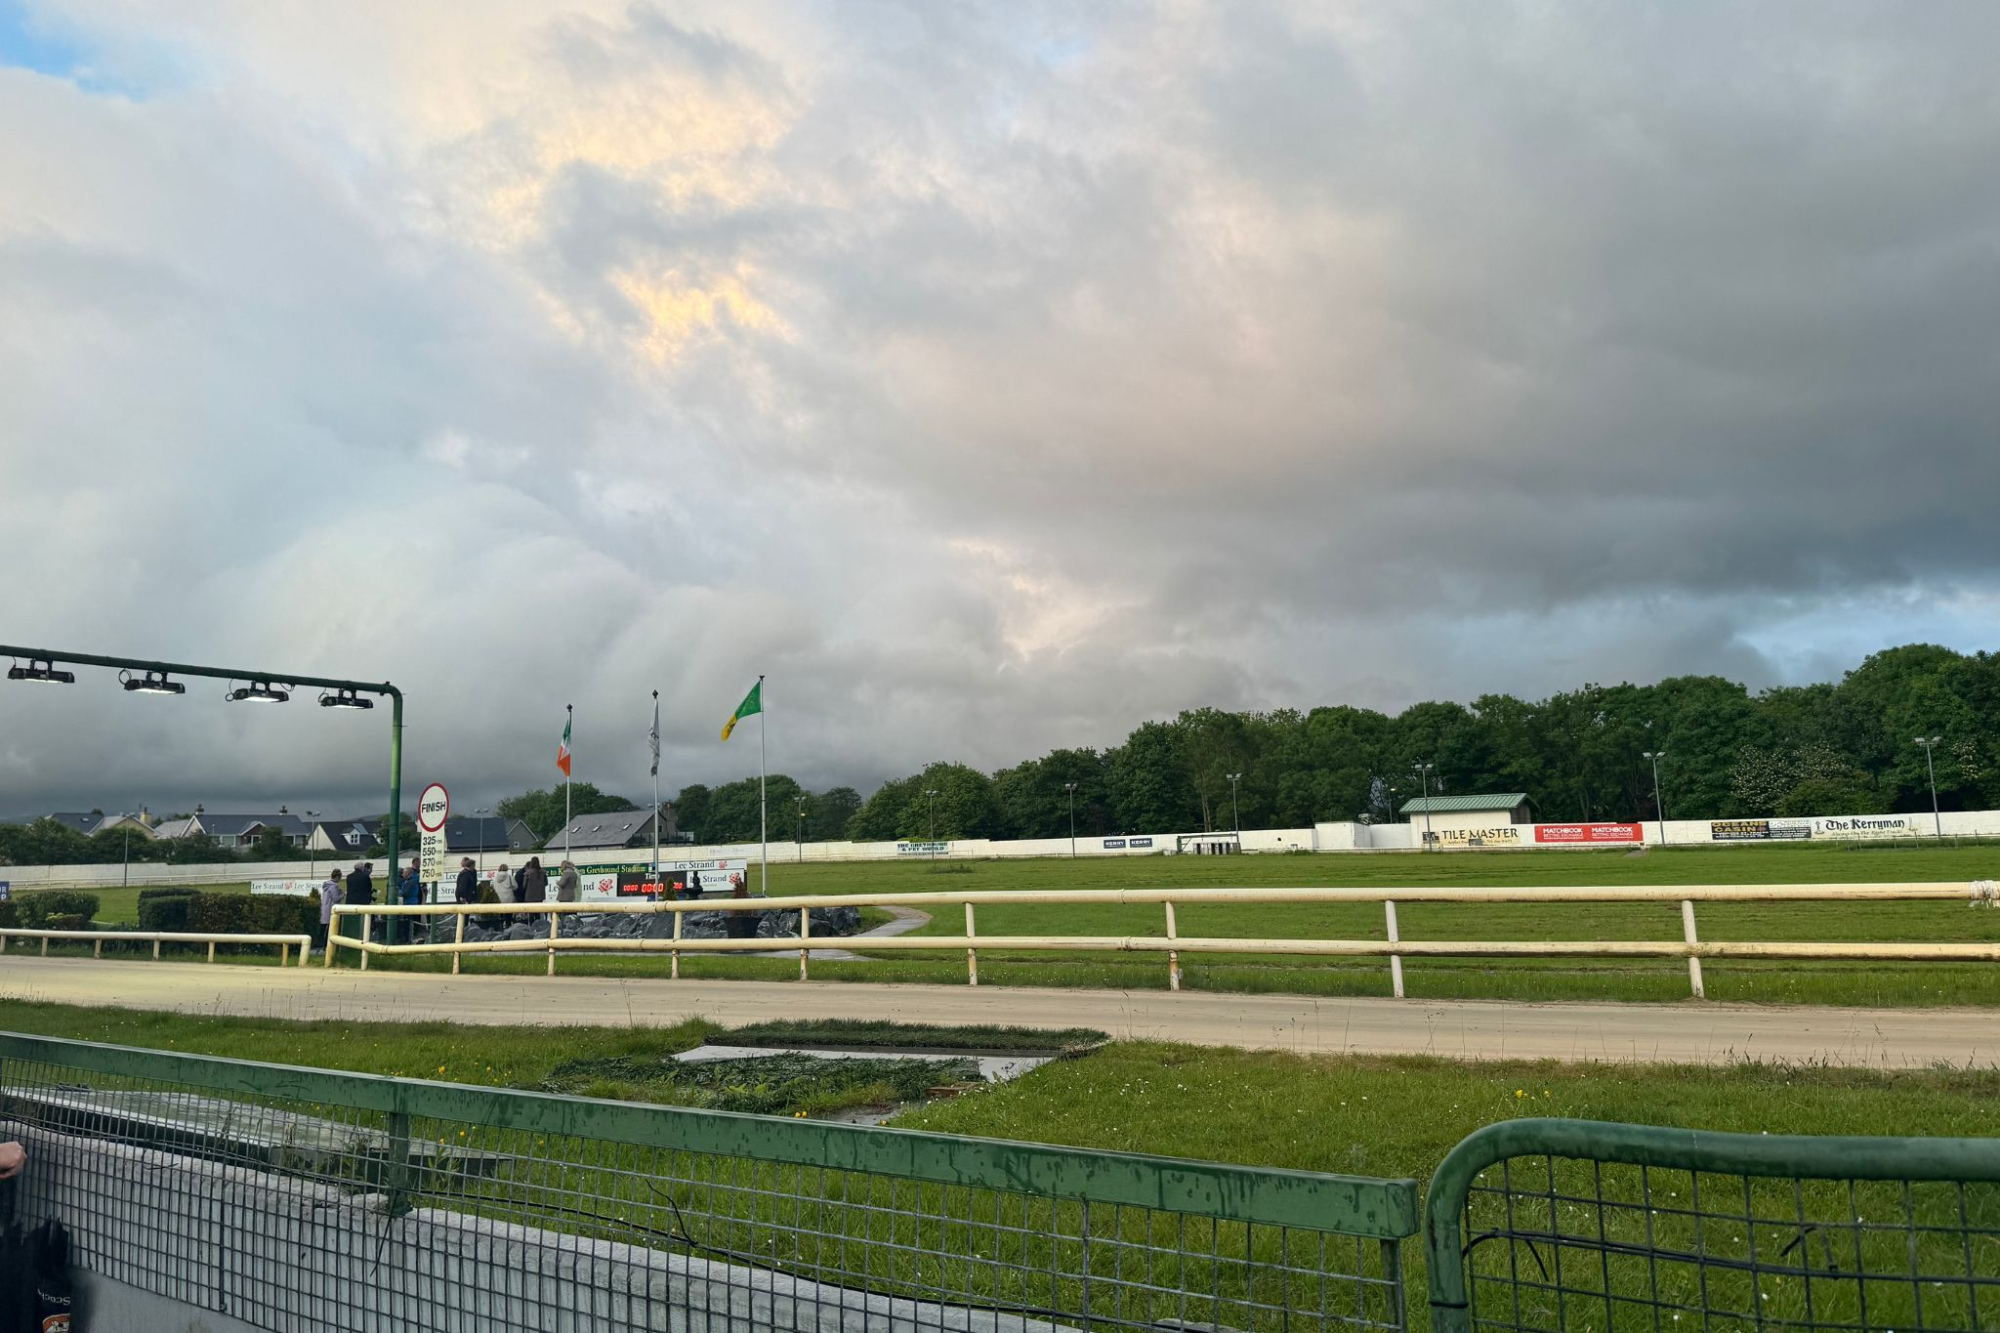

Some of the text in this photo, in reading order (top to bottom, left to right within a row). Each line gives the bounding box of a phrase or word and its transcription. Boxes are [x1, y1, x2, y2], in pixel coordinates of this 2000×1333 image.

[422, 802, 446, 813] FINISH
[1826, 820, 1849, 830] The
[1851, 818, 1904, 830] Kerryman
[1442, 830, 1466, 840] TILE
[1469, 828, 1518, 838] MASTER
[422, 836, 436, 846] 325
[422, 847, 436, 856] 550
[422, 858, 436, 867] 570
[674, 860, 714, 869] Lee Strand
[422, 869, 435, 878] 750
[586, 866, 620, 874] Greyhound
[702, 875, 726, 883] Strand
